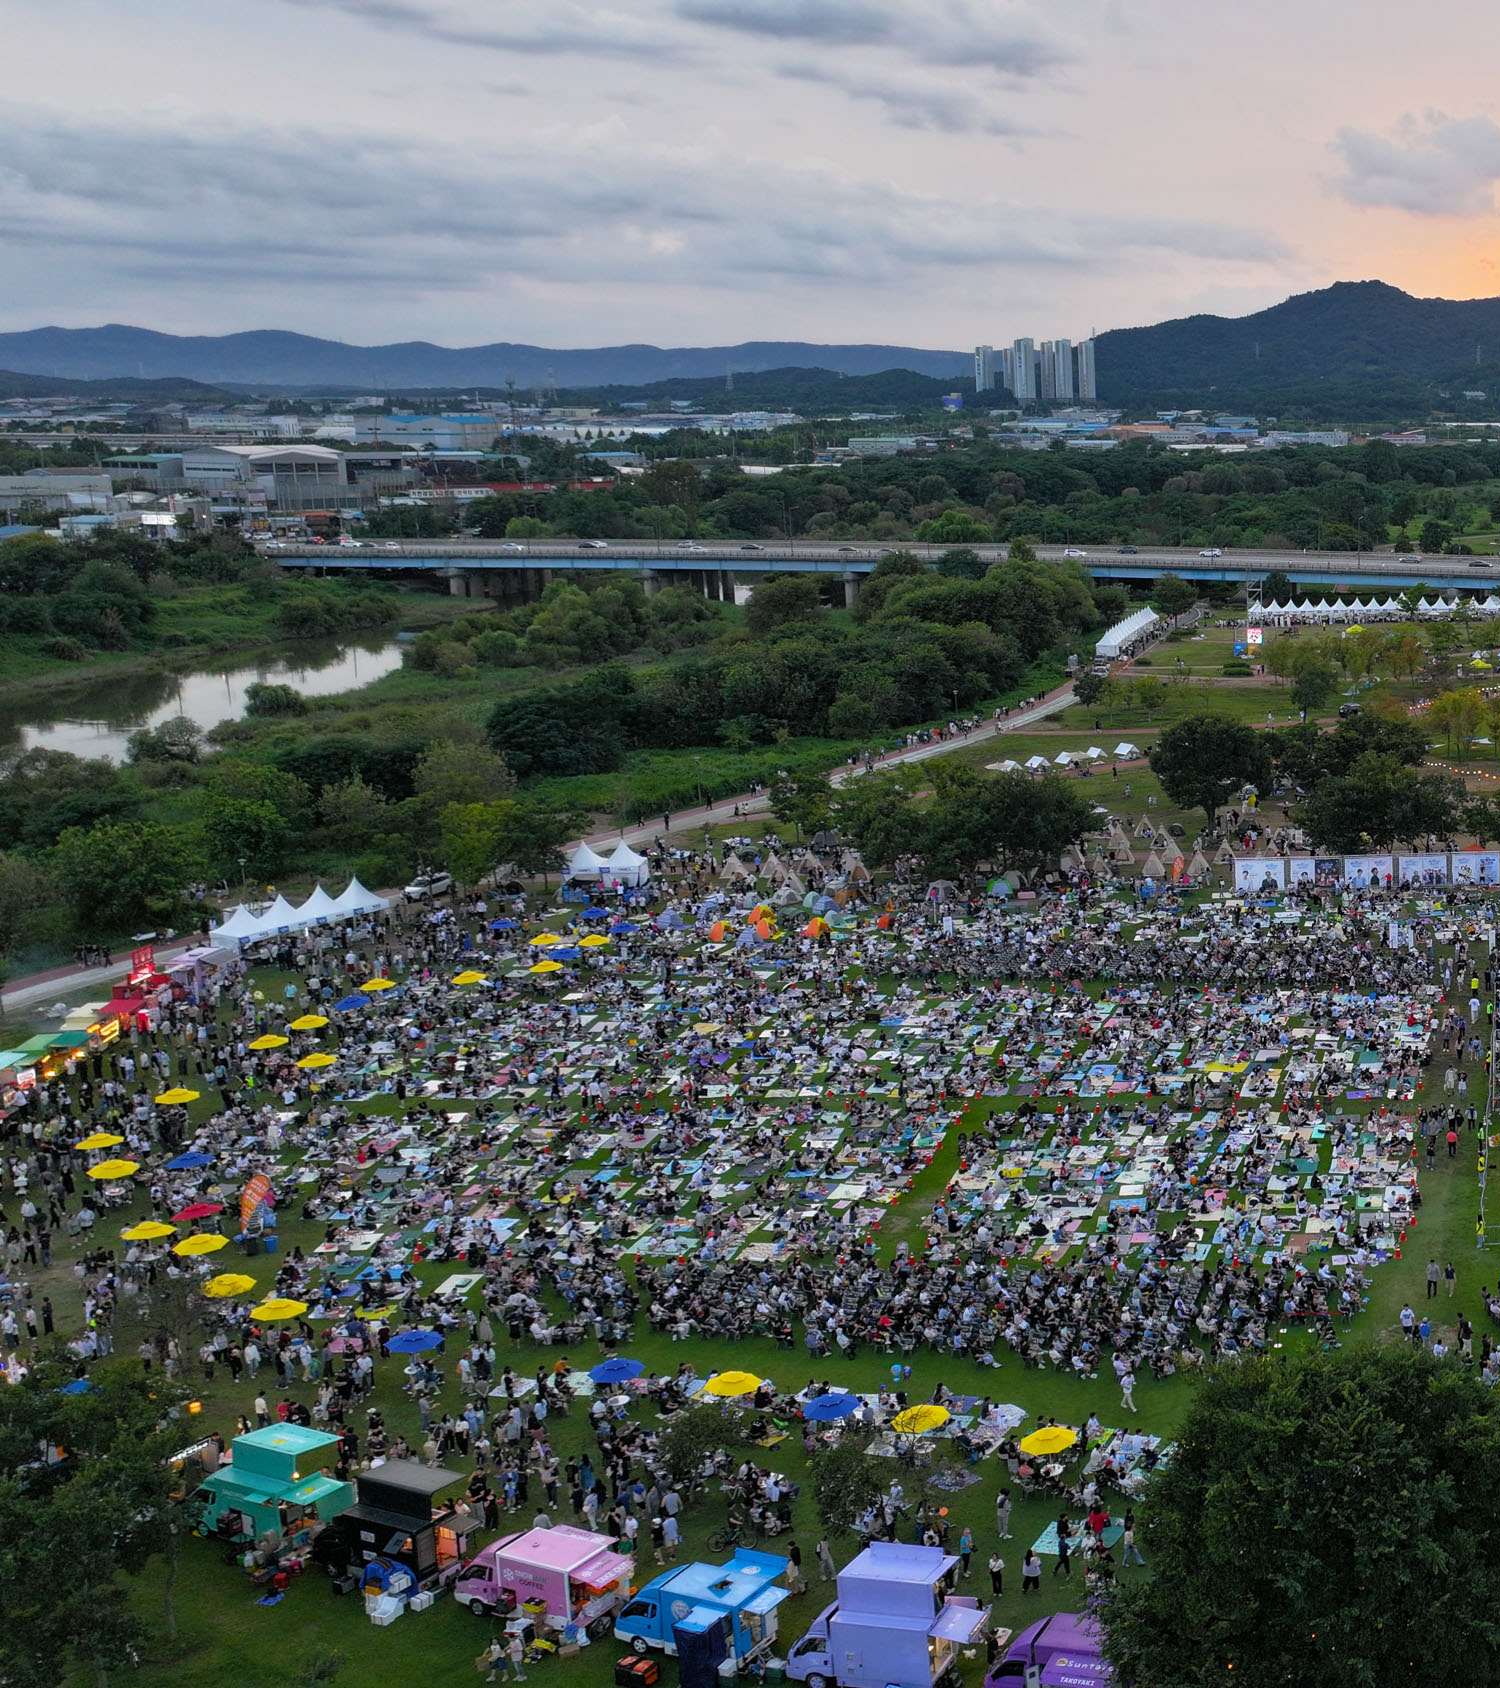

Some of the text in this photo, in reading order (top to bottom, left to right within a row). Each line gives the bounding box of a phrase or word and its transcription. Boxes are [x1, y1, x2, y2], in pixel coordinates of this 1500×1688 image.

[596, 1571, 615, 1584] TAKE
[613, 1561, 629, 1574] OUT
[519, 1578, 544, 1590] COFFEE
[1060, 1677, 1095, 1686] TAKOYAKI
